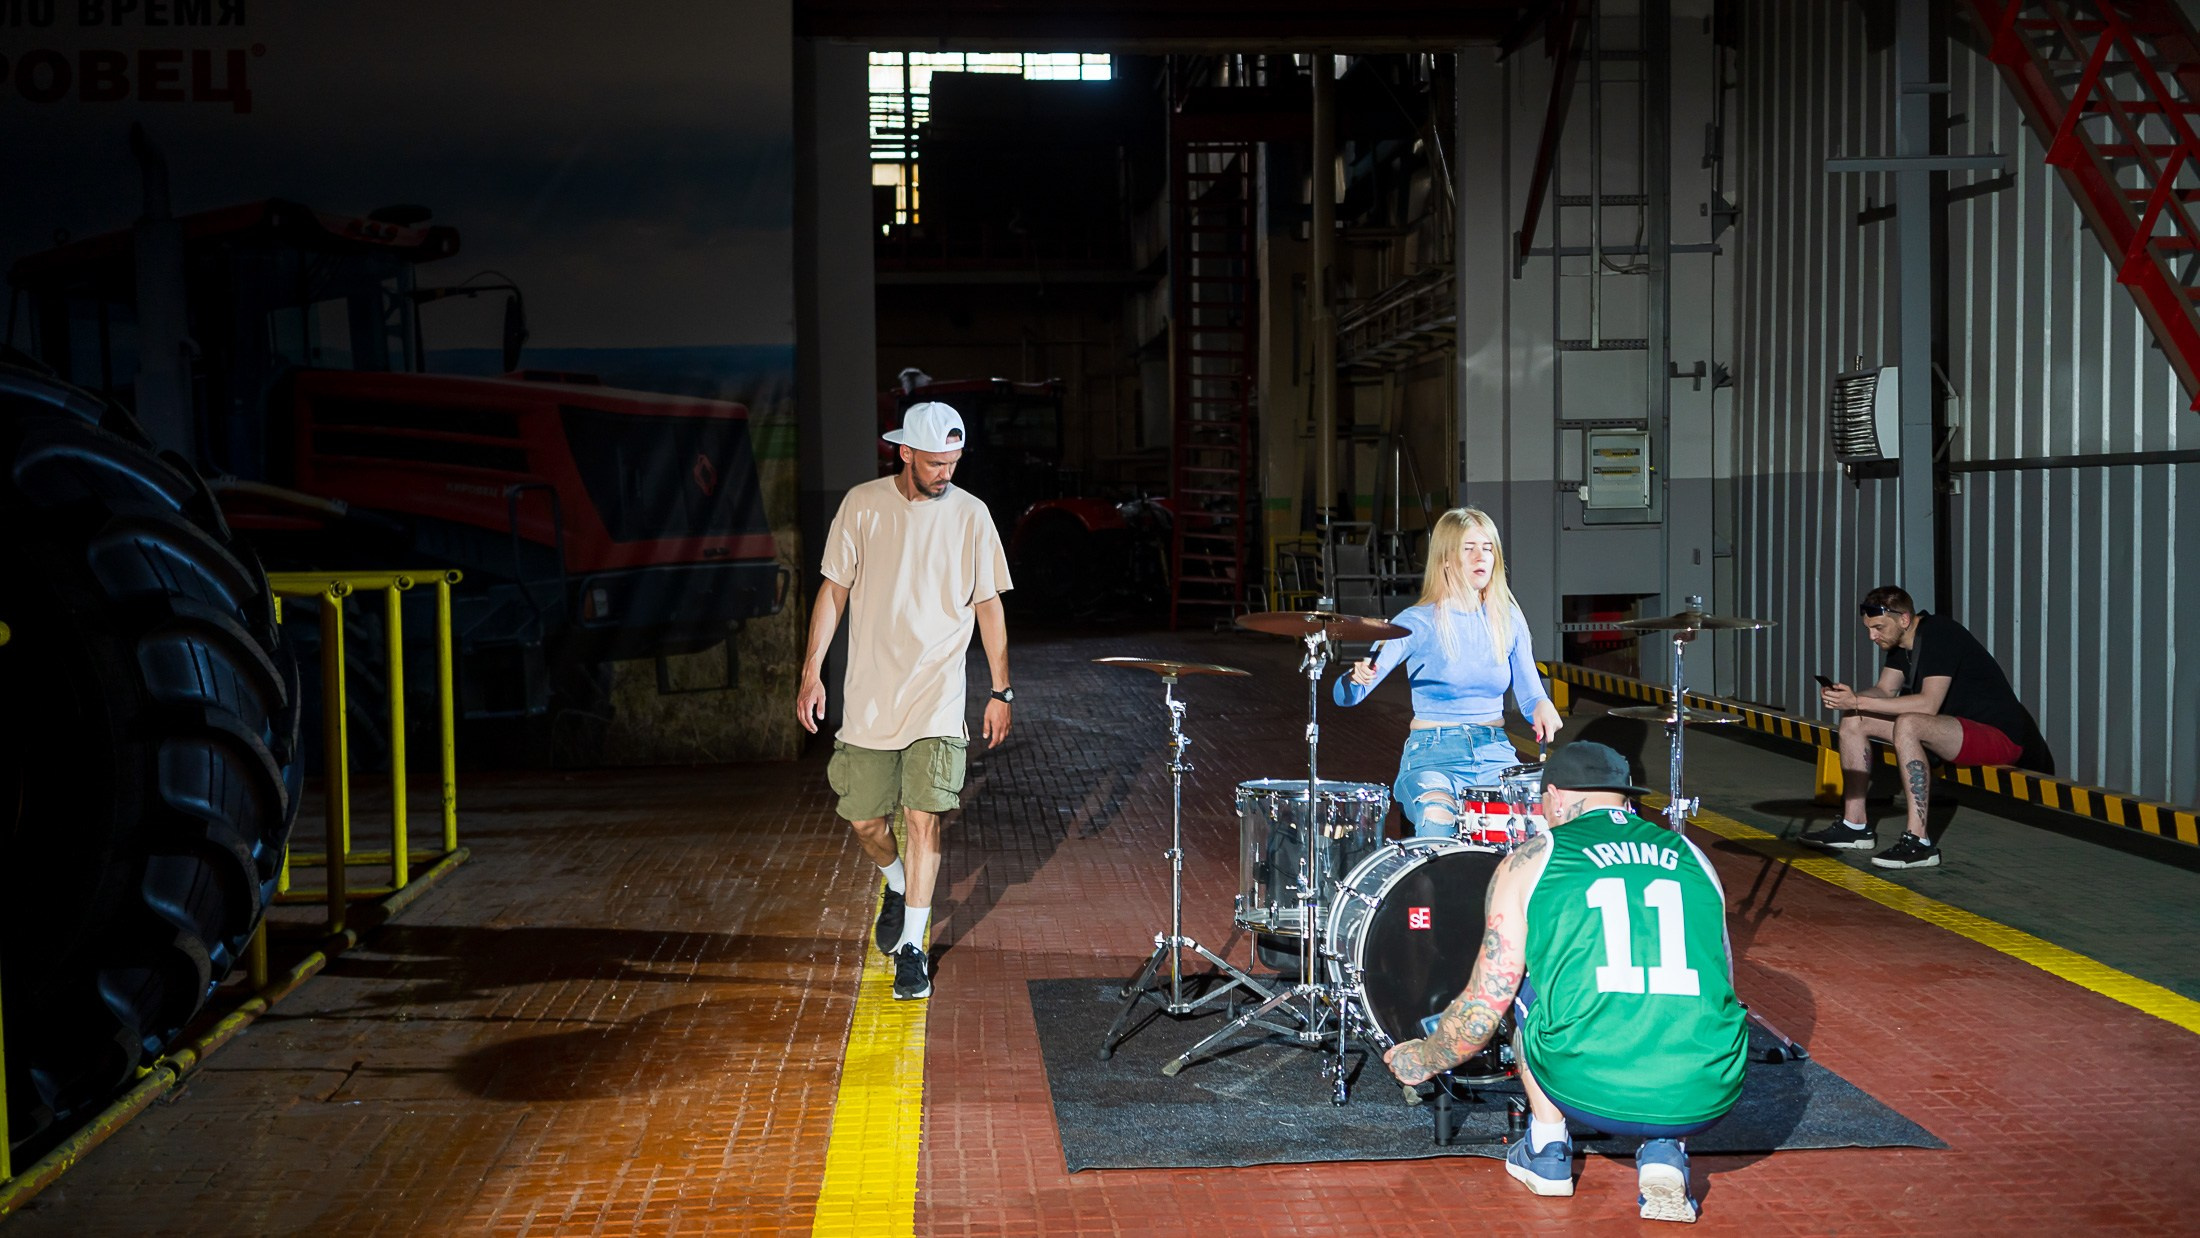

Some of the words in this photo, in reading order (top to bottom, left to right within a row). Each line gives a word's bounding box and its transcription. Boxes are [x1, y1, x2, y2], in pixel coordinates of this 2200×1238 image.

[78, 0, 245, 26] ВРЕМЯ
[0, 49, 252, 113] ОВЕЦ
[1582, 842, 1679, 870] IRVING
[1586, 877, 1700, 996] 11
